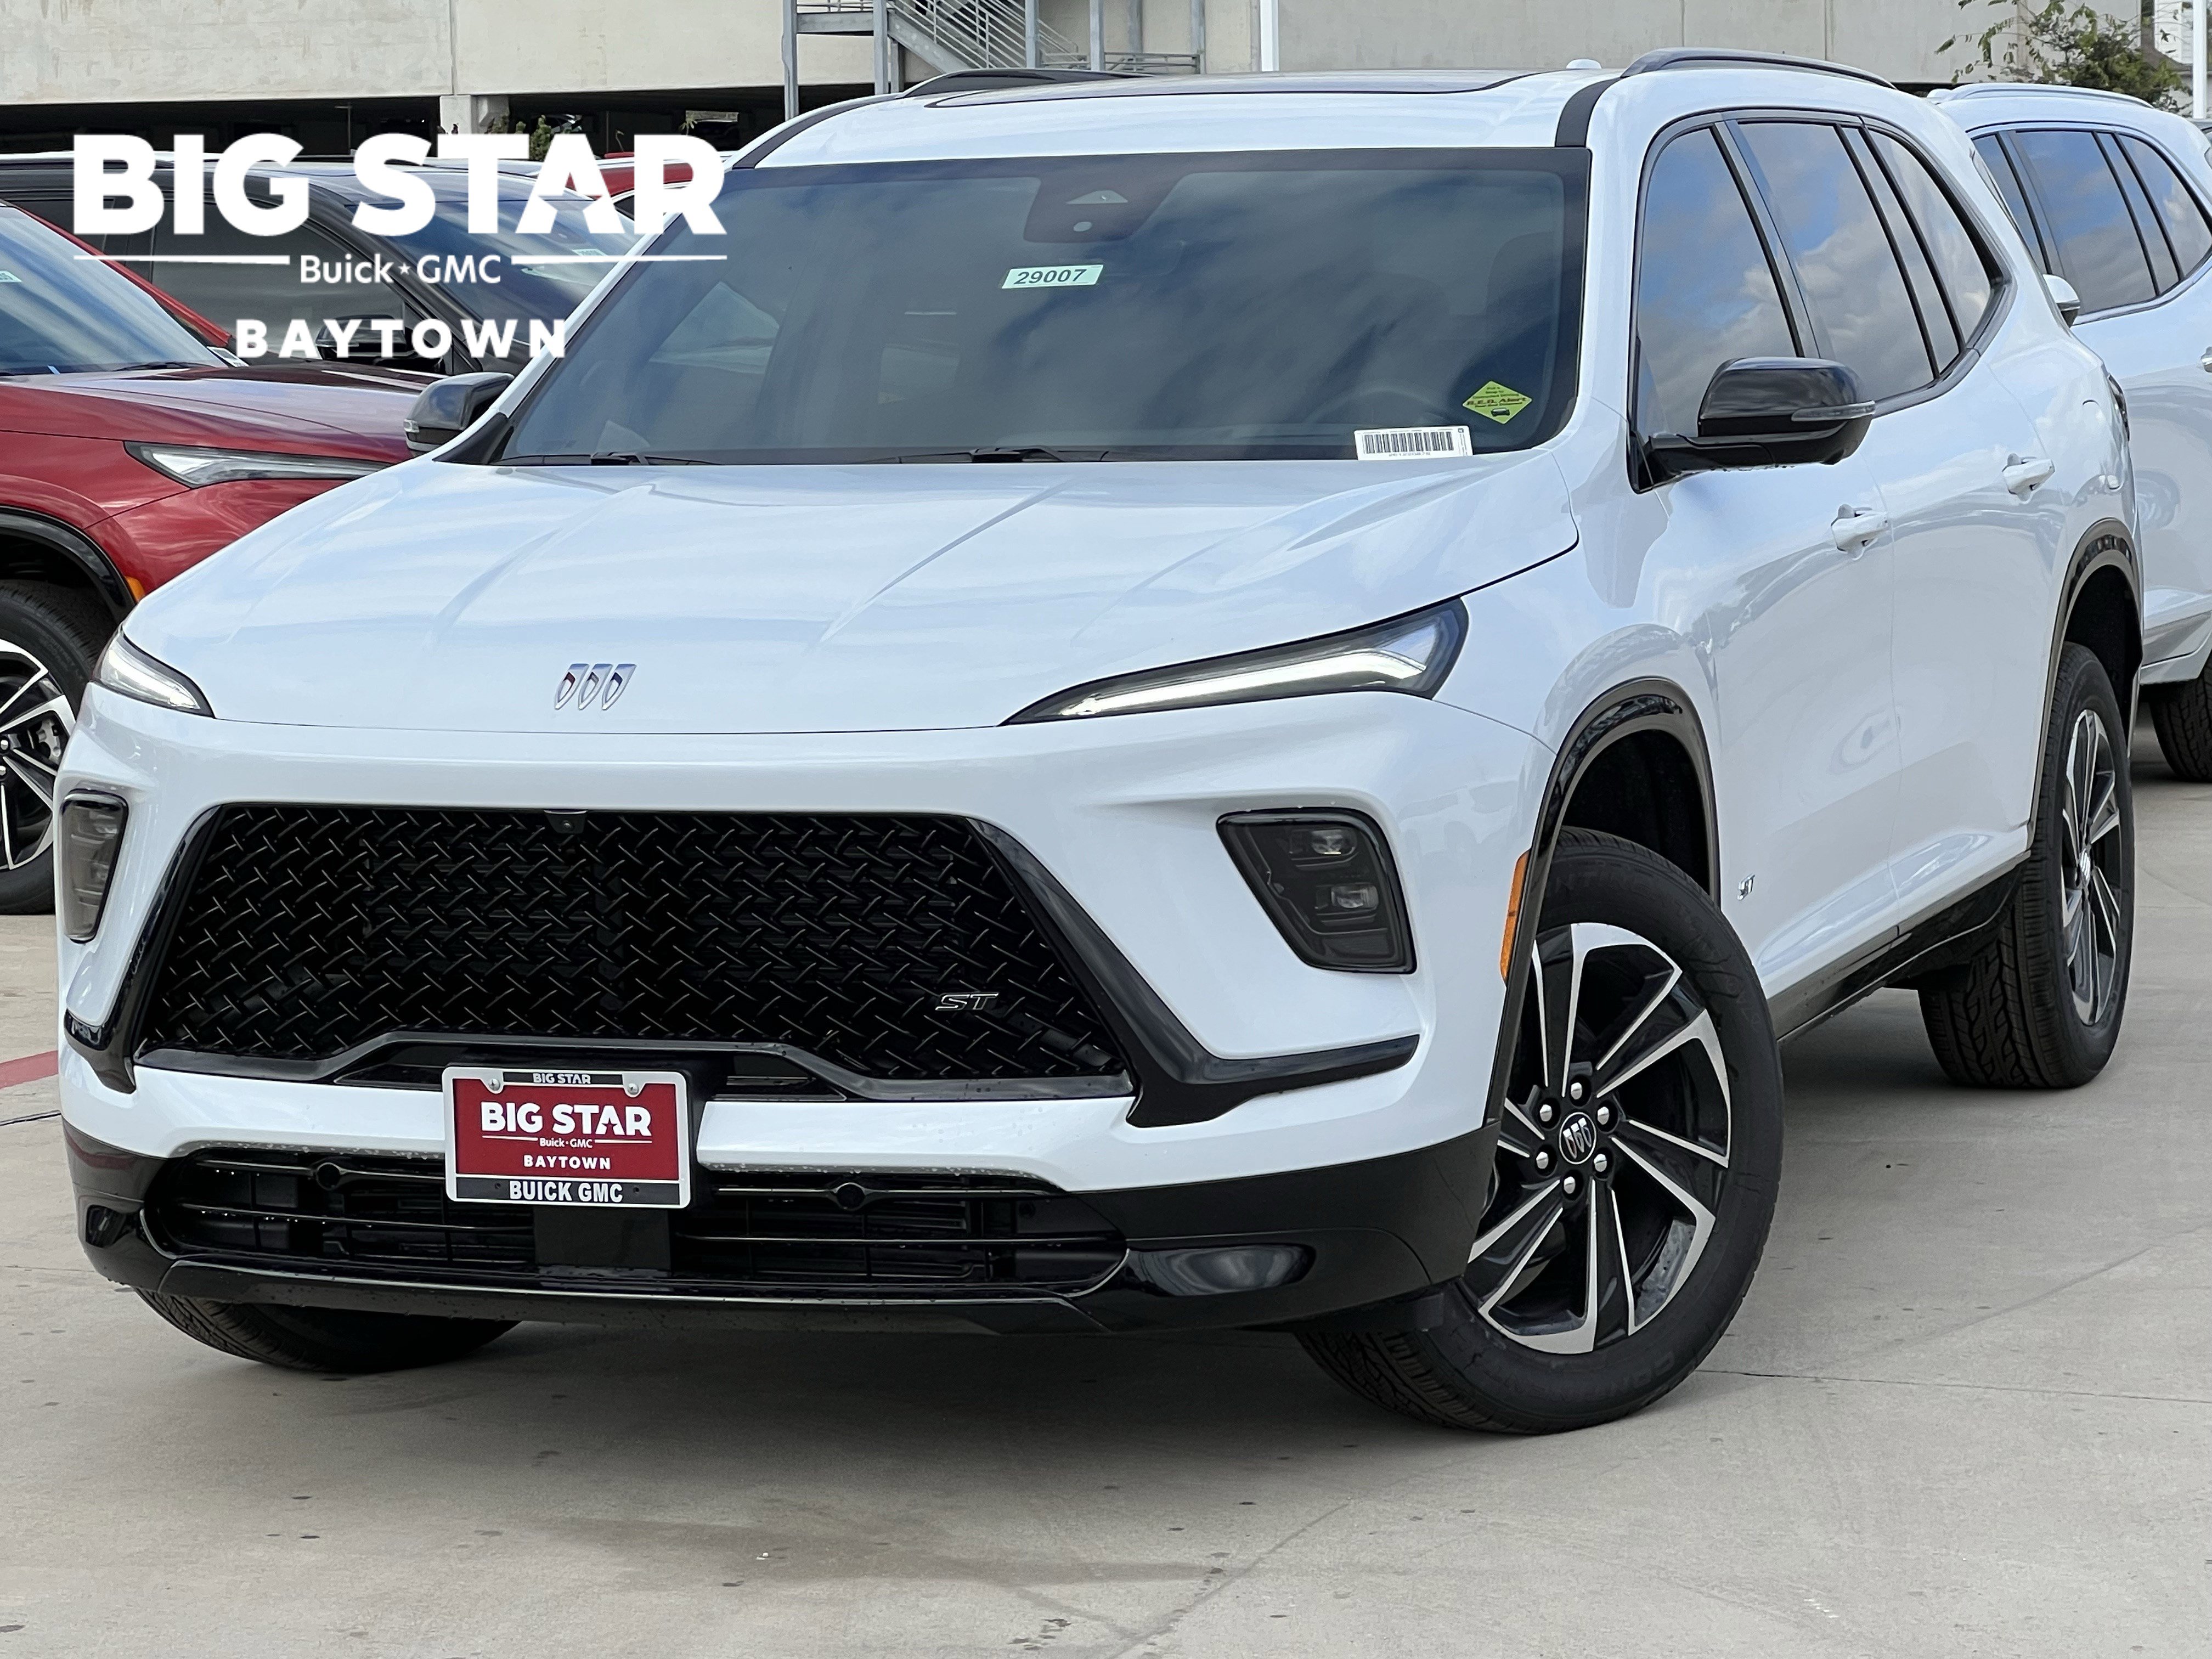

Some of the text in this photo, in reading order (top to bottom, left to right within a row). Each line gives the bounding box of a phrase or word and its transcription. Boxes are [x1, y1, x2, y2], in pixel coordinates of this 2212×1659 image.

[1013, 268, 1087, 285] 29007
[935, 992, 1000, 1011] ST
[532, 1073, 591, 1085] BIG STAR
[481, 1101, 652, 1137] BIG STAR
[539, 1137, 593, 1148] Buick GMC
[523, 1154, 611, 1170] BAYTOWN
[509, 1181, 623, 1203] BUICK GMC
